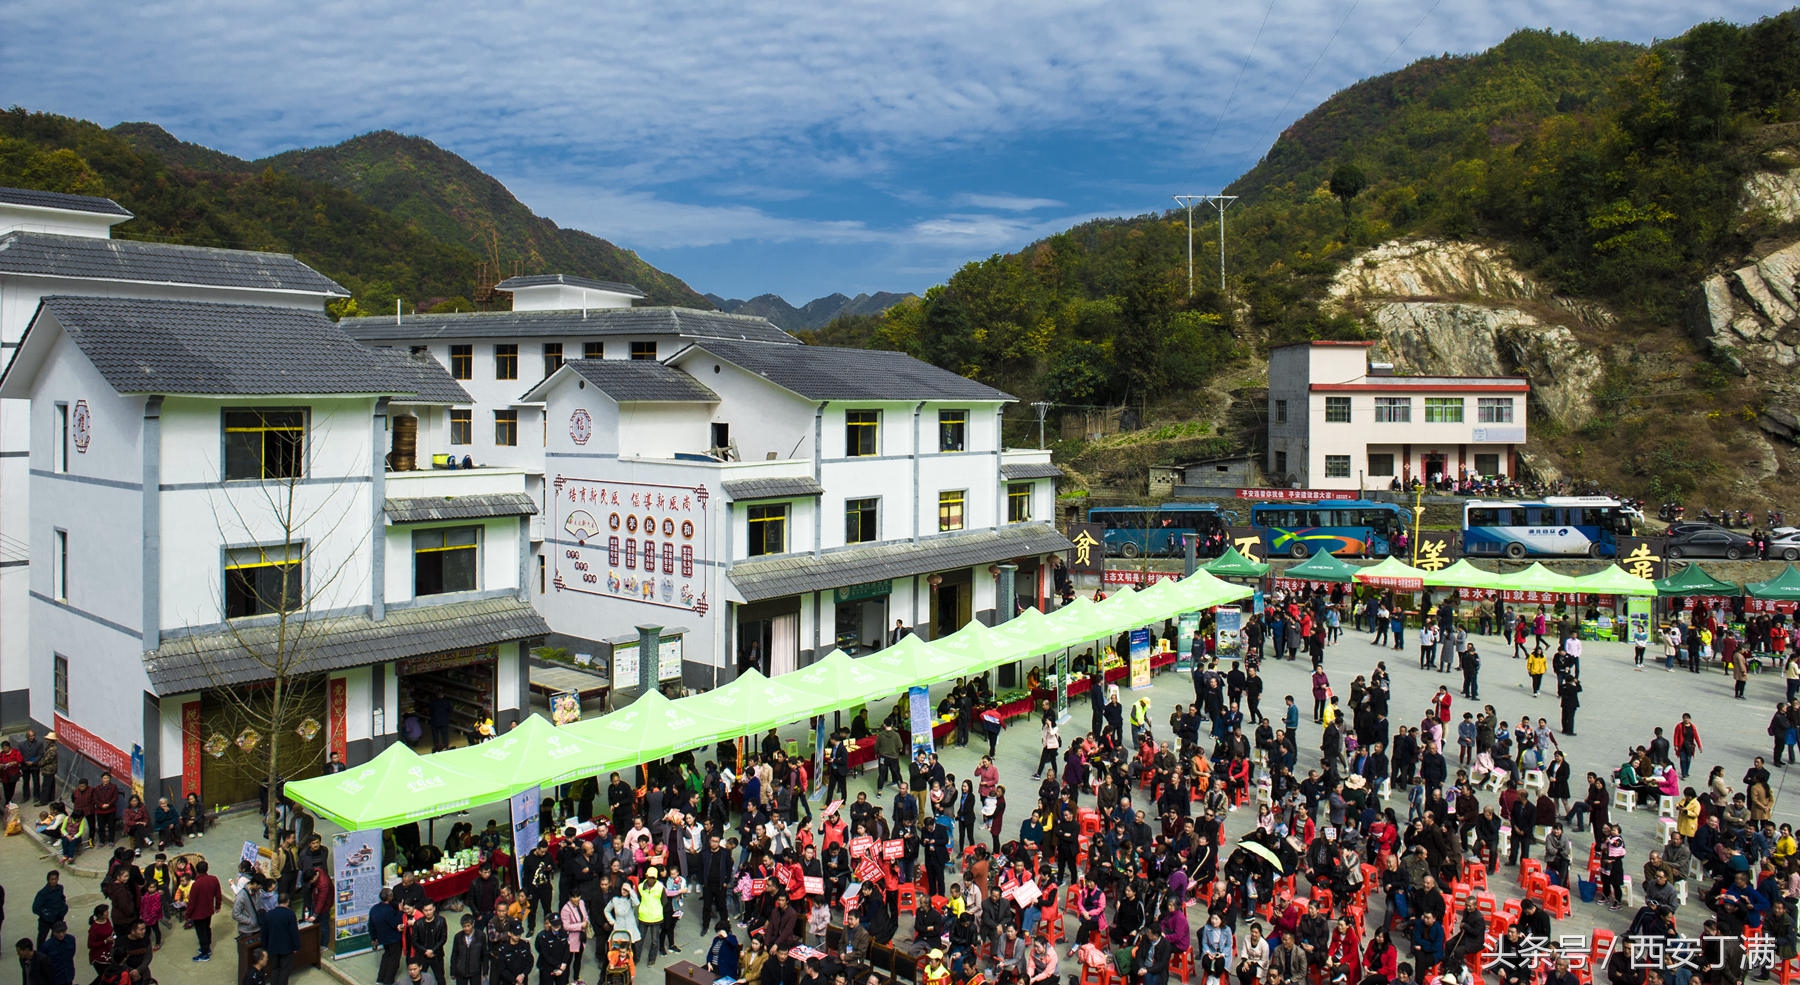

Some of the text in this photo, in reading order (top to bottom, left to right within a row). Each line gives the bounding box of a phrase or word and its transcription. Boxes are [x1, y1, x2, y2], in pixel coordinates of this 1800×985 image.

[1072, 529, 1099, 566] 贫
[1234, 535, 1261, 563] 不
[1416, 539, 1450, 572] 等
[1622, 543, 1661, 581] 靠
